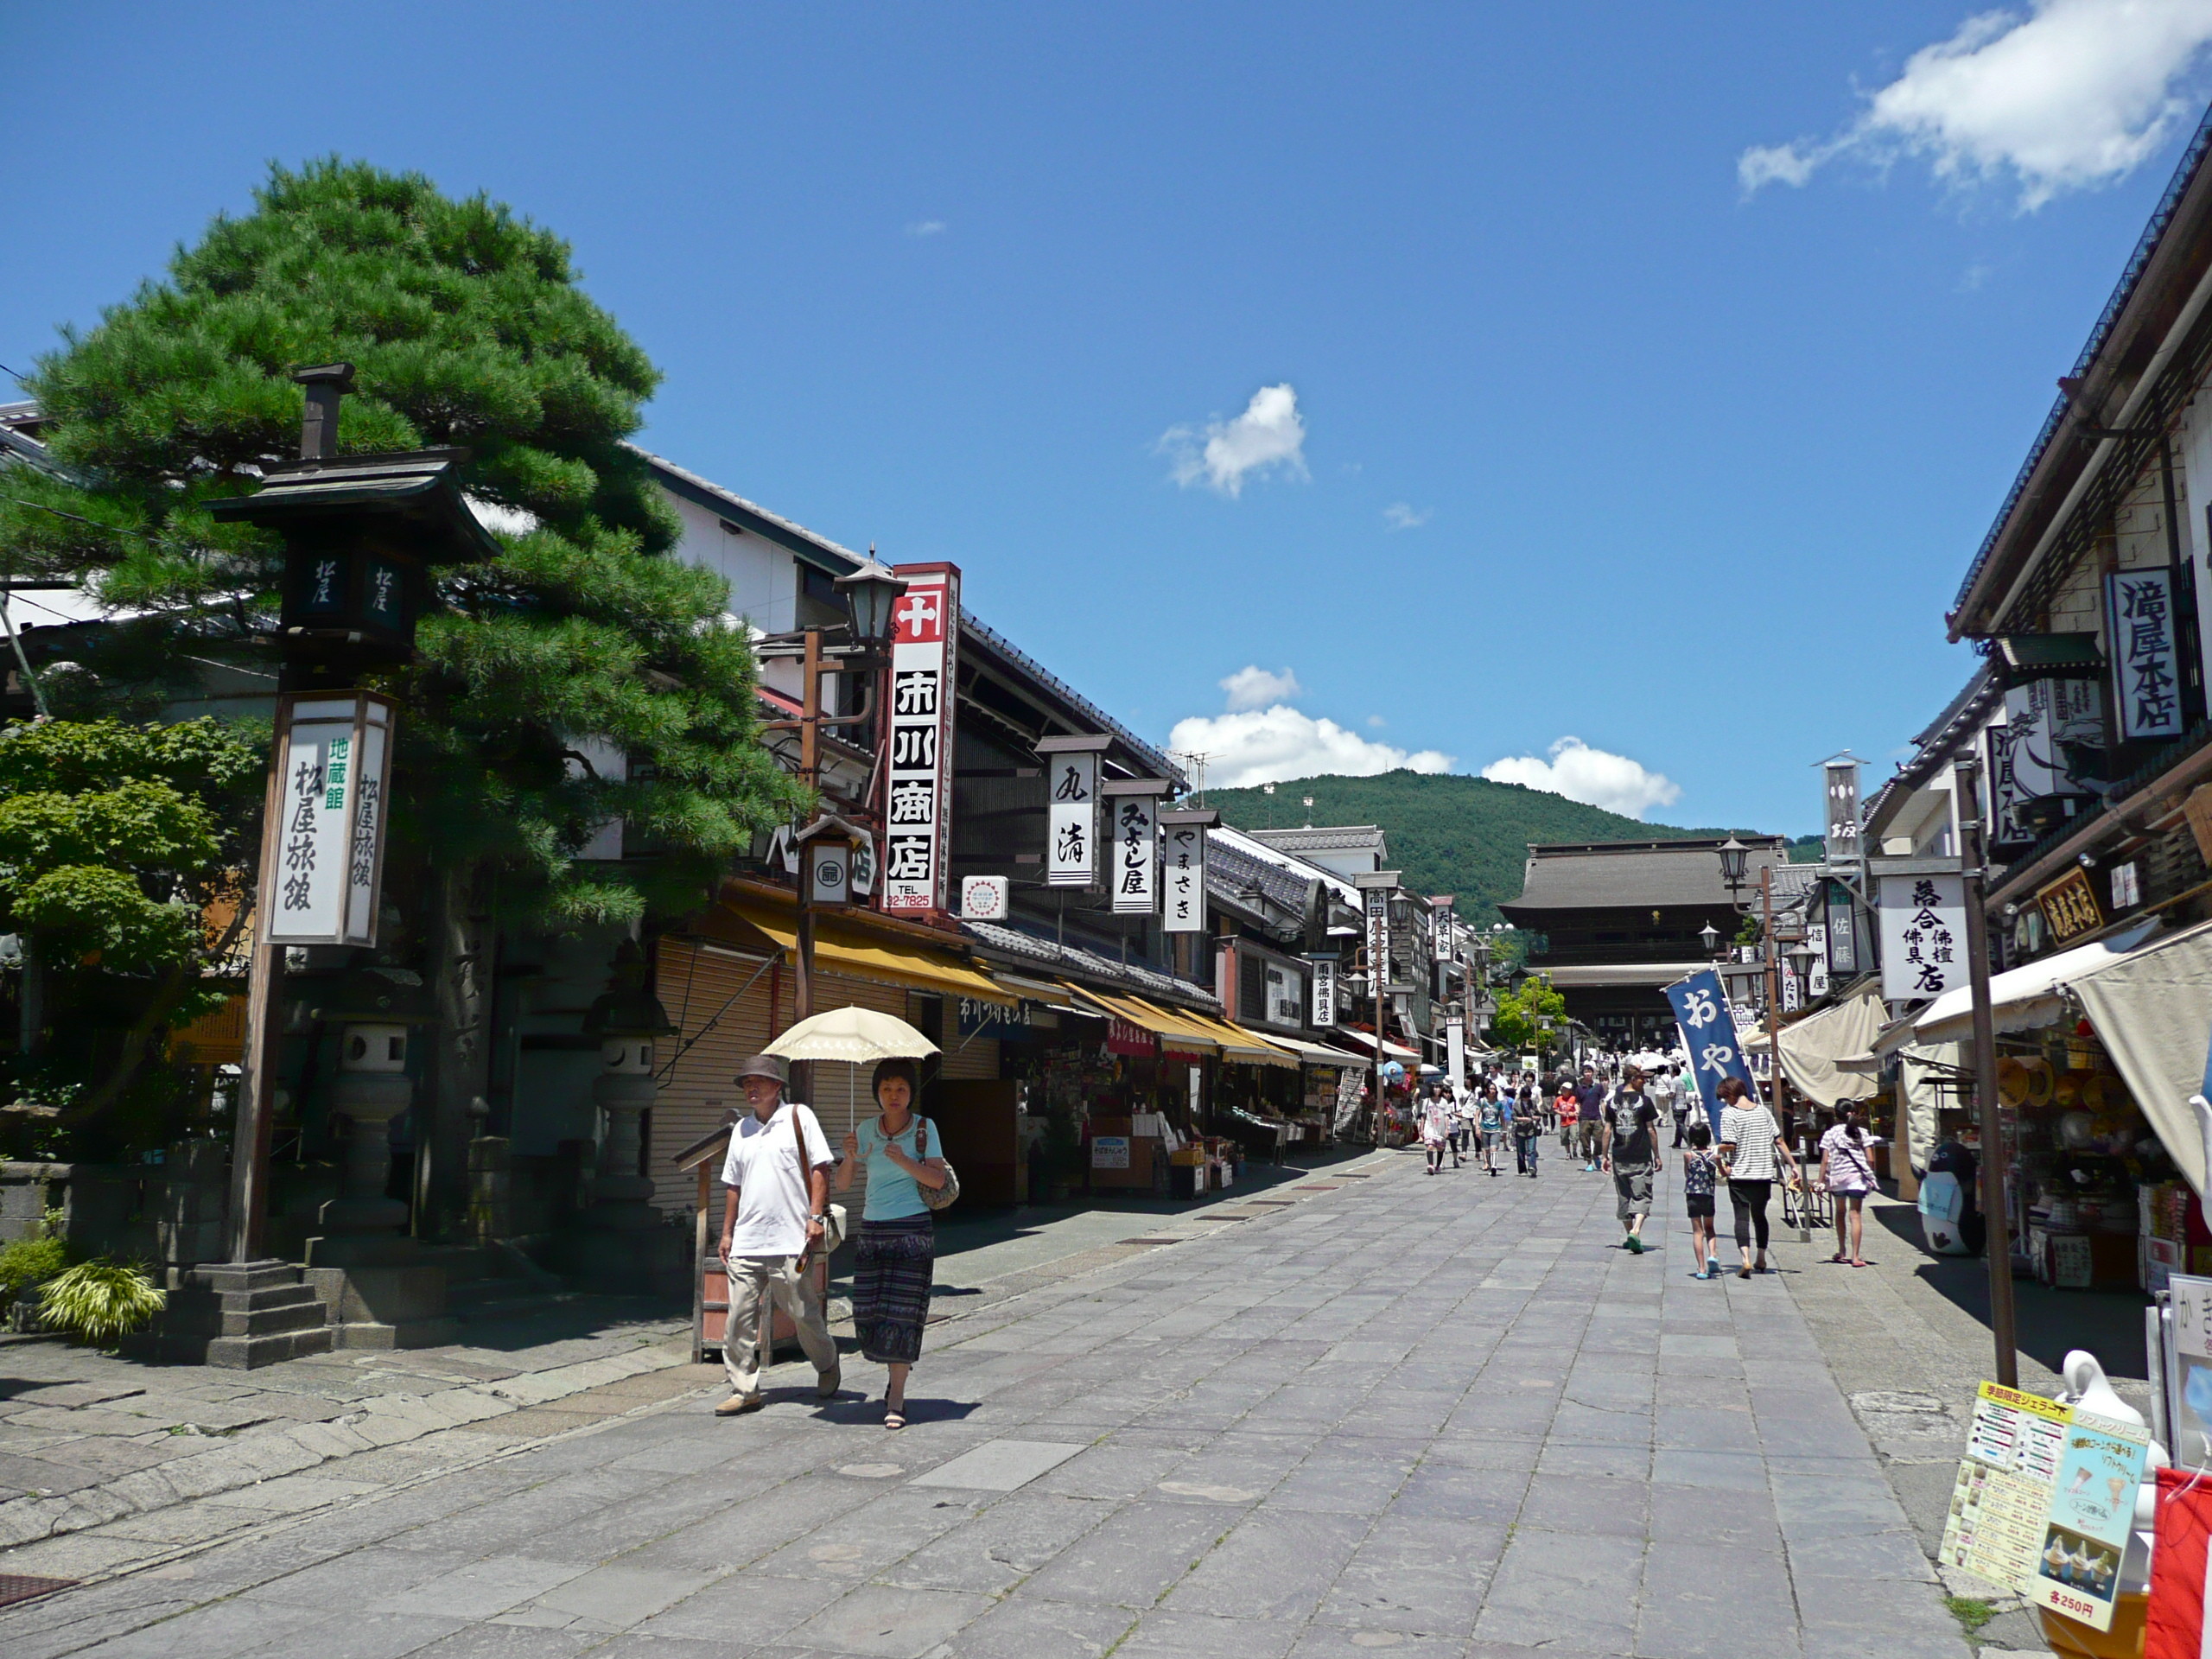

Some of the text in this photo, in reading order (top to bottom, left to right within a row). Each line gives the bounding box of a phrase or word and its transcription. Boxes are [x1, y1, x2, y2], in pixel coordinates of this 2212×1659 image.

[313, 559, 335, 603] 松屋
[372, 566, 392, 612] 松屋
[2120, 581, 2175, 729] 滝屋本店
[324, 737, 349, 810] 地蔵館
[889, 671, 938, 880] 市川商店
[283, 761, 323, 912] 松屋旅館
[352, 773, 378, 887] 松屋旅館
[1056, 766, 1088, 863] 丸清
[1121, 803, 1149, 894] みよし屋
[899, 885, 918, 893] TEL
[1173, 830, 1195, 919] やまさき
[887, 895, 930, 907] 32-7825
[1911, 880, 1944, 929] 落合
[1833, 918, 1852, 963] 佐藤
[1317, 963, 1330, 1022] 雨宮佛具店
[1913, 963, 1944, 992] 店
[1683, 988, 1732, 1079] おや
[1986, 1384, 2068, 1416] 季節限定ジェラート
[2078, 1414, 2146, 1442] ソフトクリーム
[2102, 1455, 2135, 1484] ソフトクリーム
[2050, 1590, 2094, 1618] 各250円
